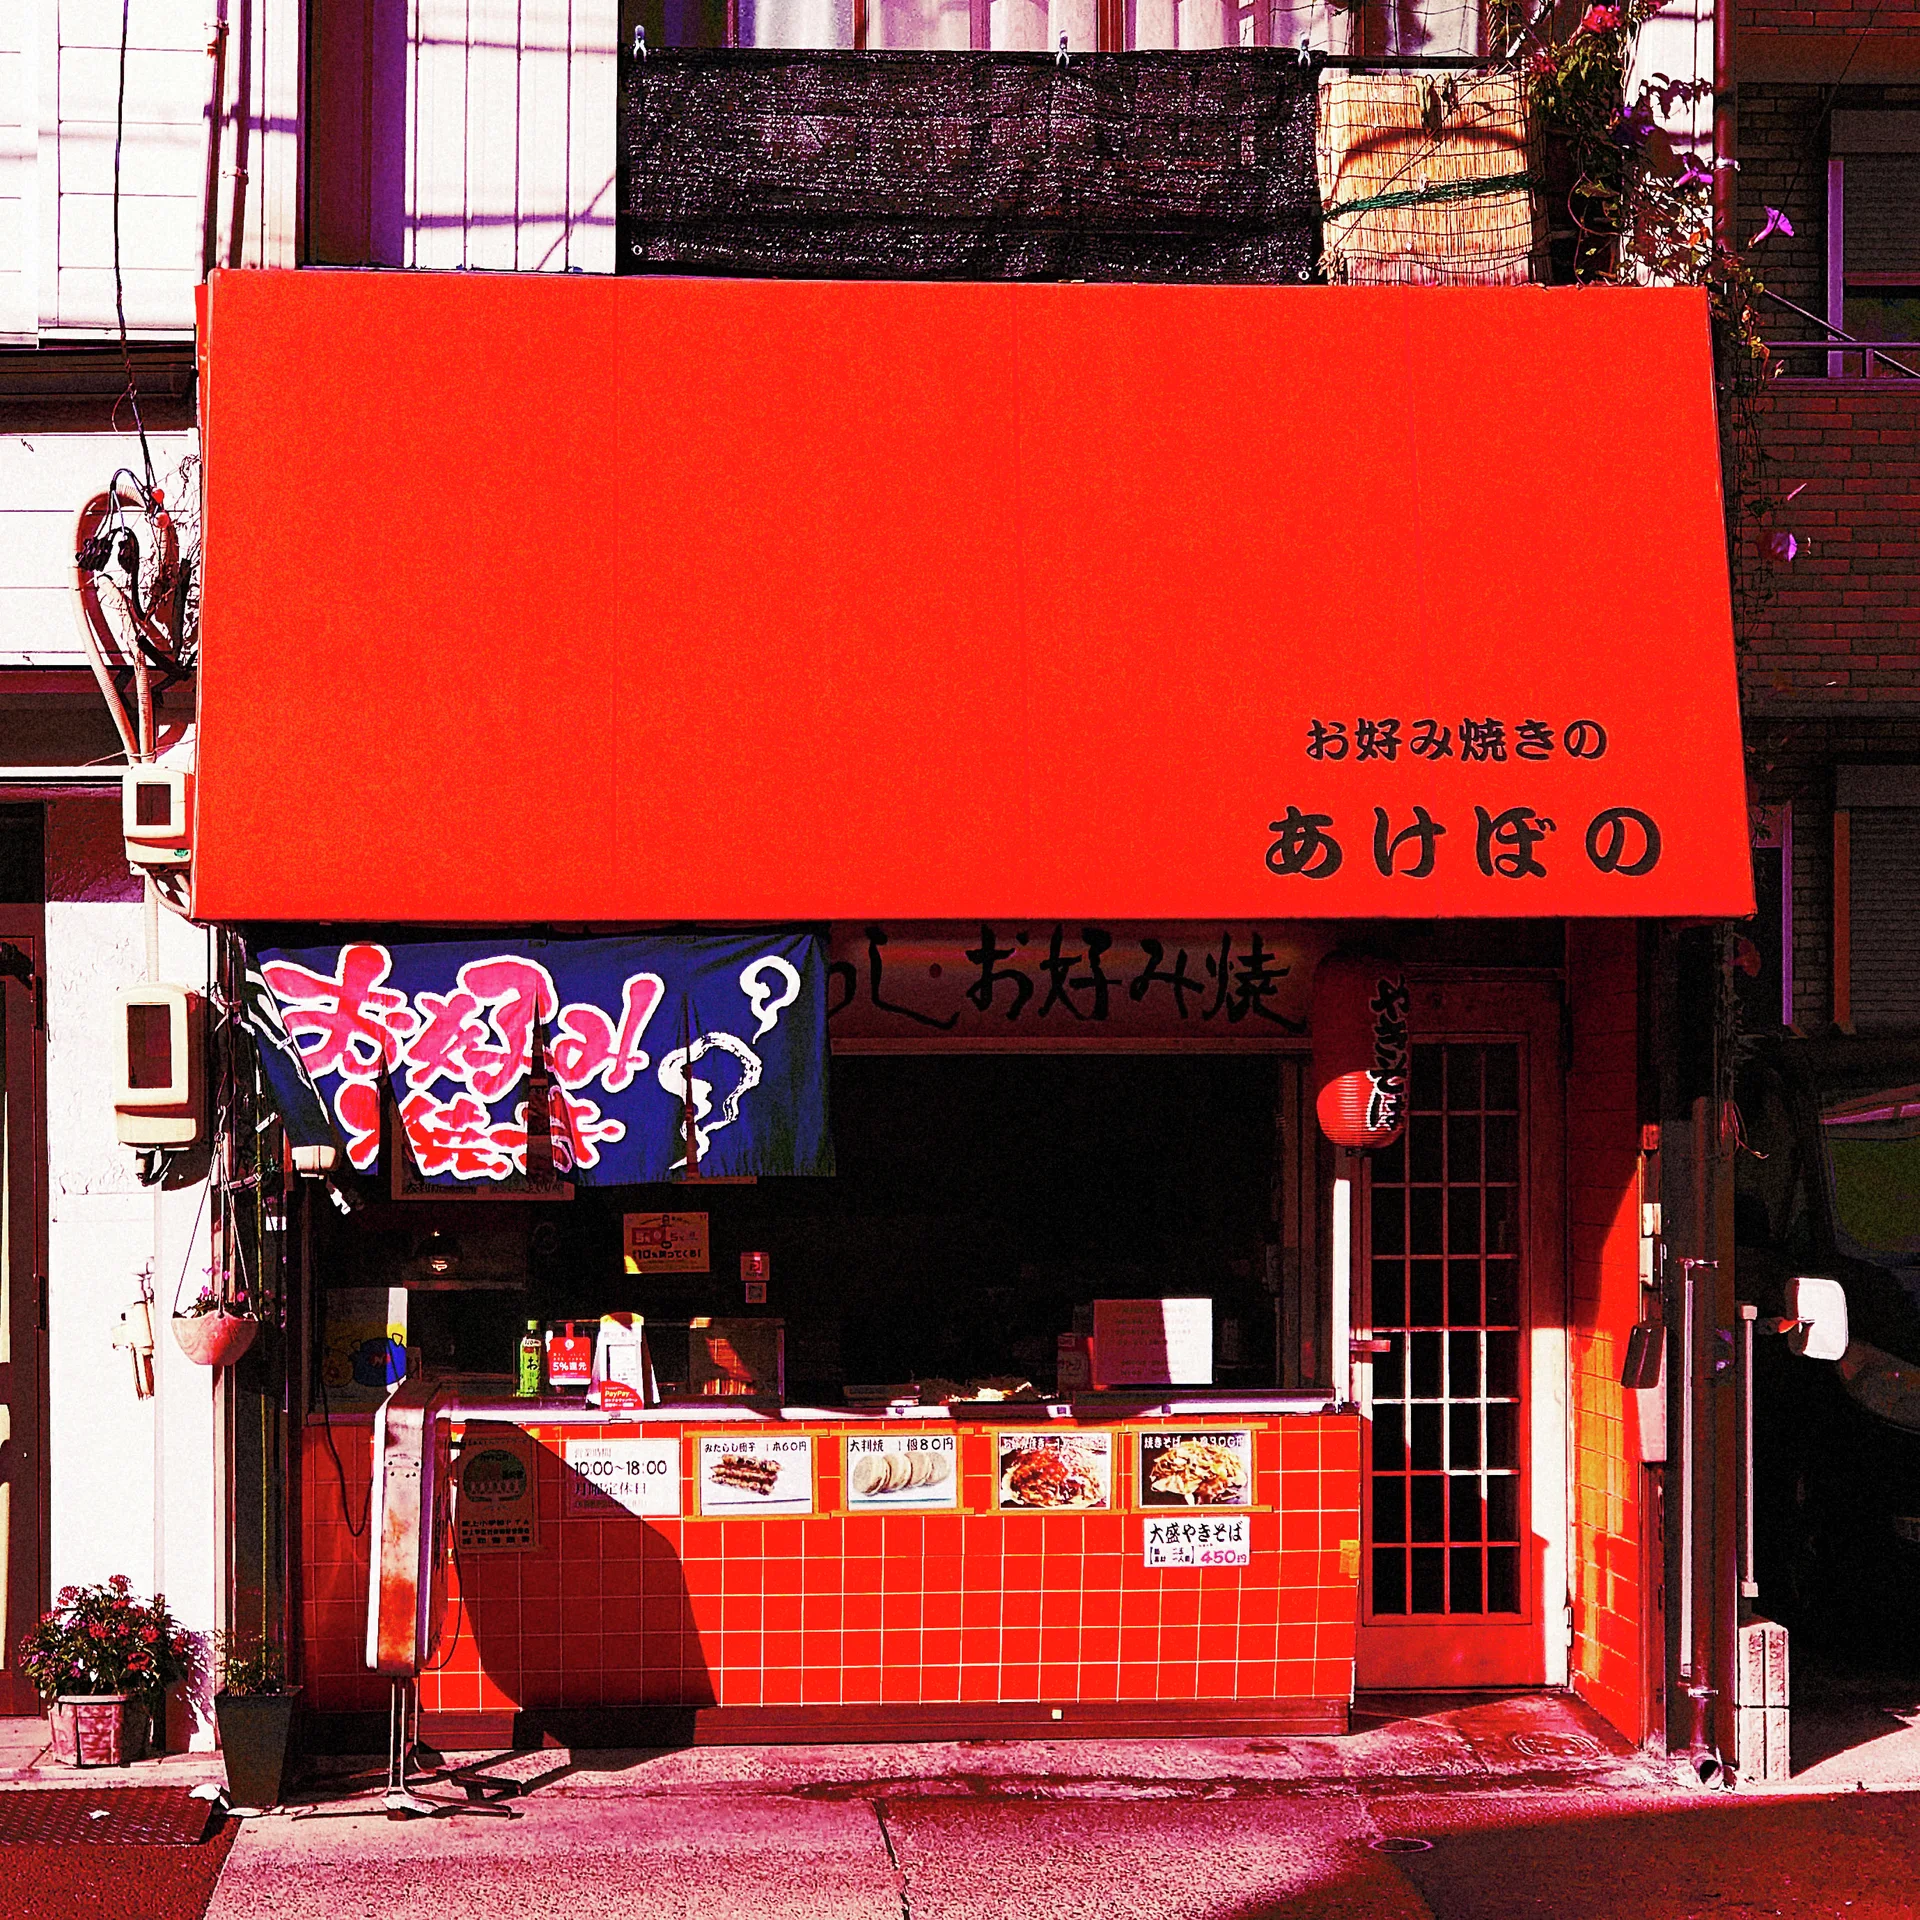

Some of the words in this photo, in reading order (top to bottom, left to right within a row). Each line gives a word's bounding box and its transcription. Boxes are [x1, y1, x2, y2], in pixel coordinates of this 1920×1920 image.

[1305, 717, 1608, 762] お好み焼きの
[1264, 805, 1663, 879] あけぼの
[261, 942, 666, 1100] お好み
[1368, 971, 1409, 1131] やきそば
[604, 1390, 630, 1398] PayPay
[704, 1441, 756, 1453] みたらし団子
[849, 1439, 884, 1453] 大判焼
[1149, 1521, 1244, 1544] 大盛やきそば
[1200, 1549, 1247, 1564] 450円
